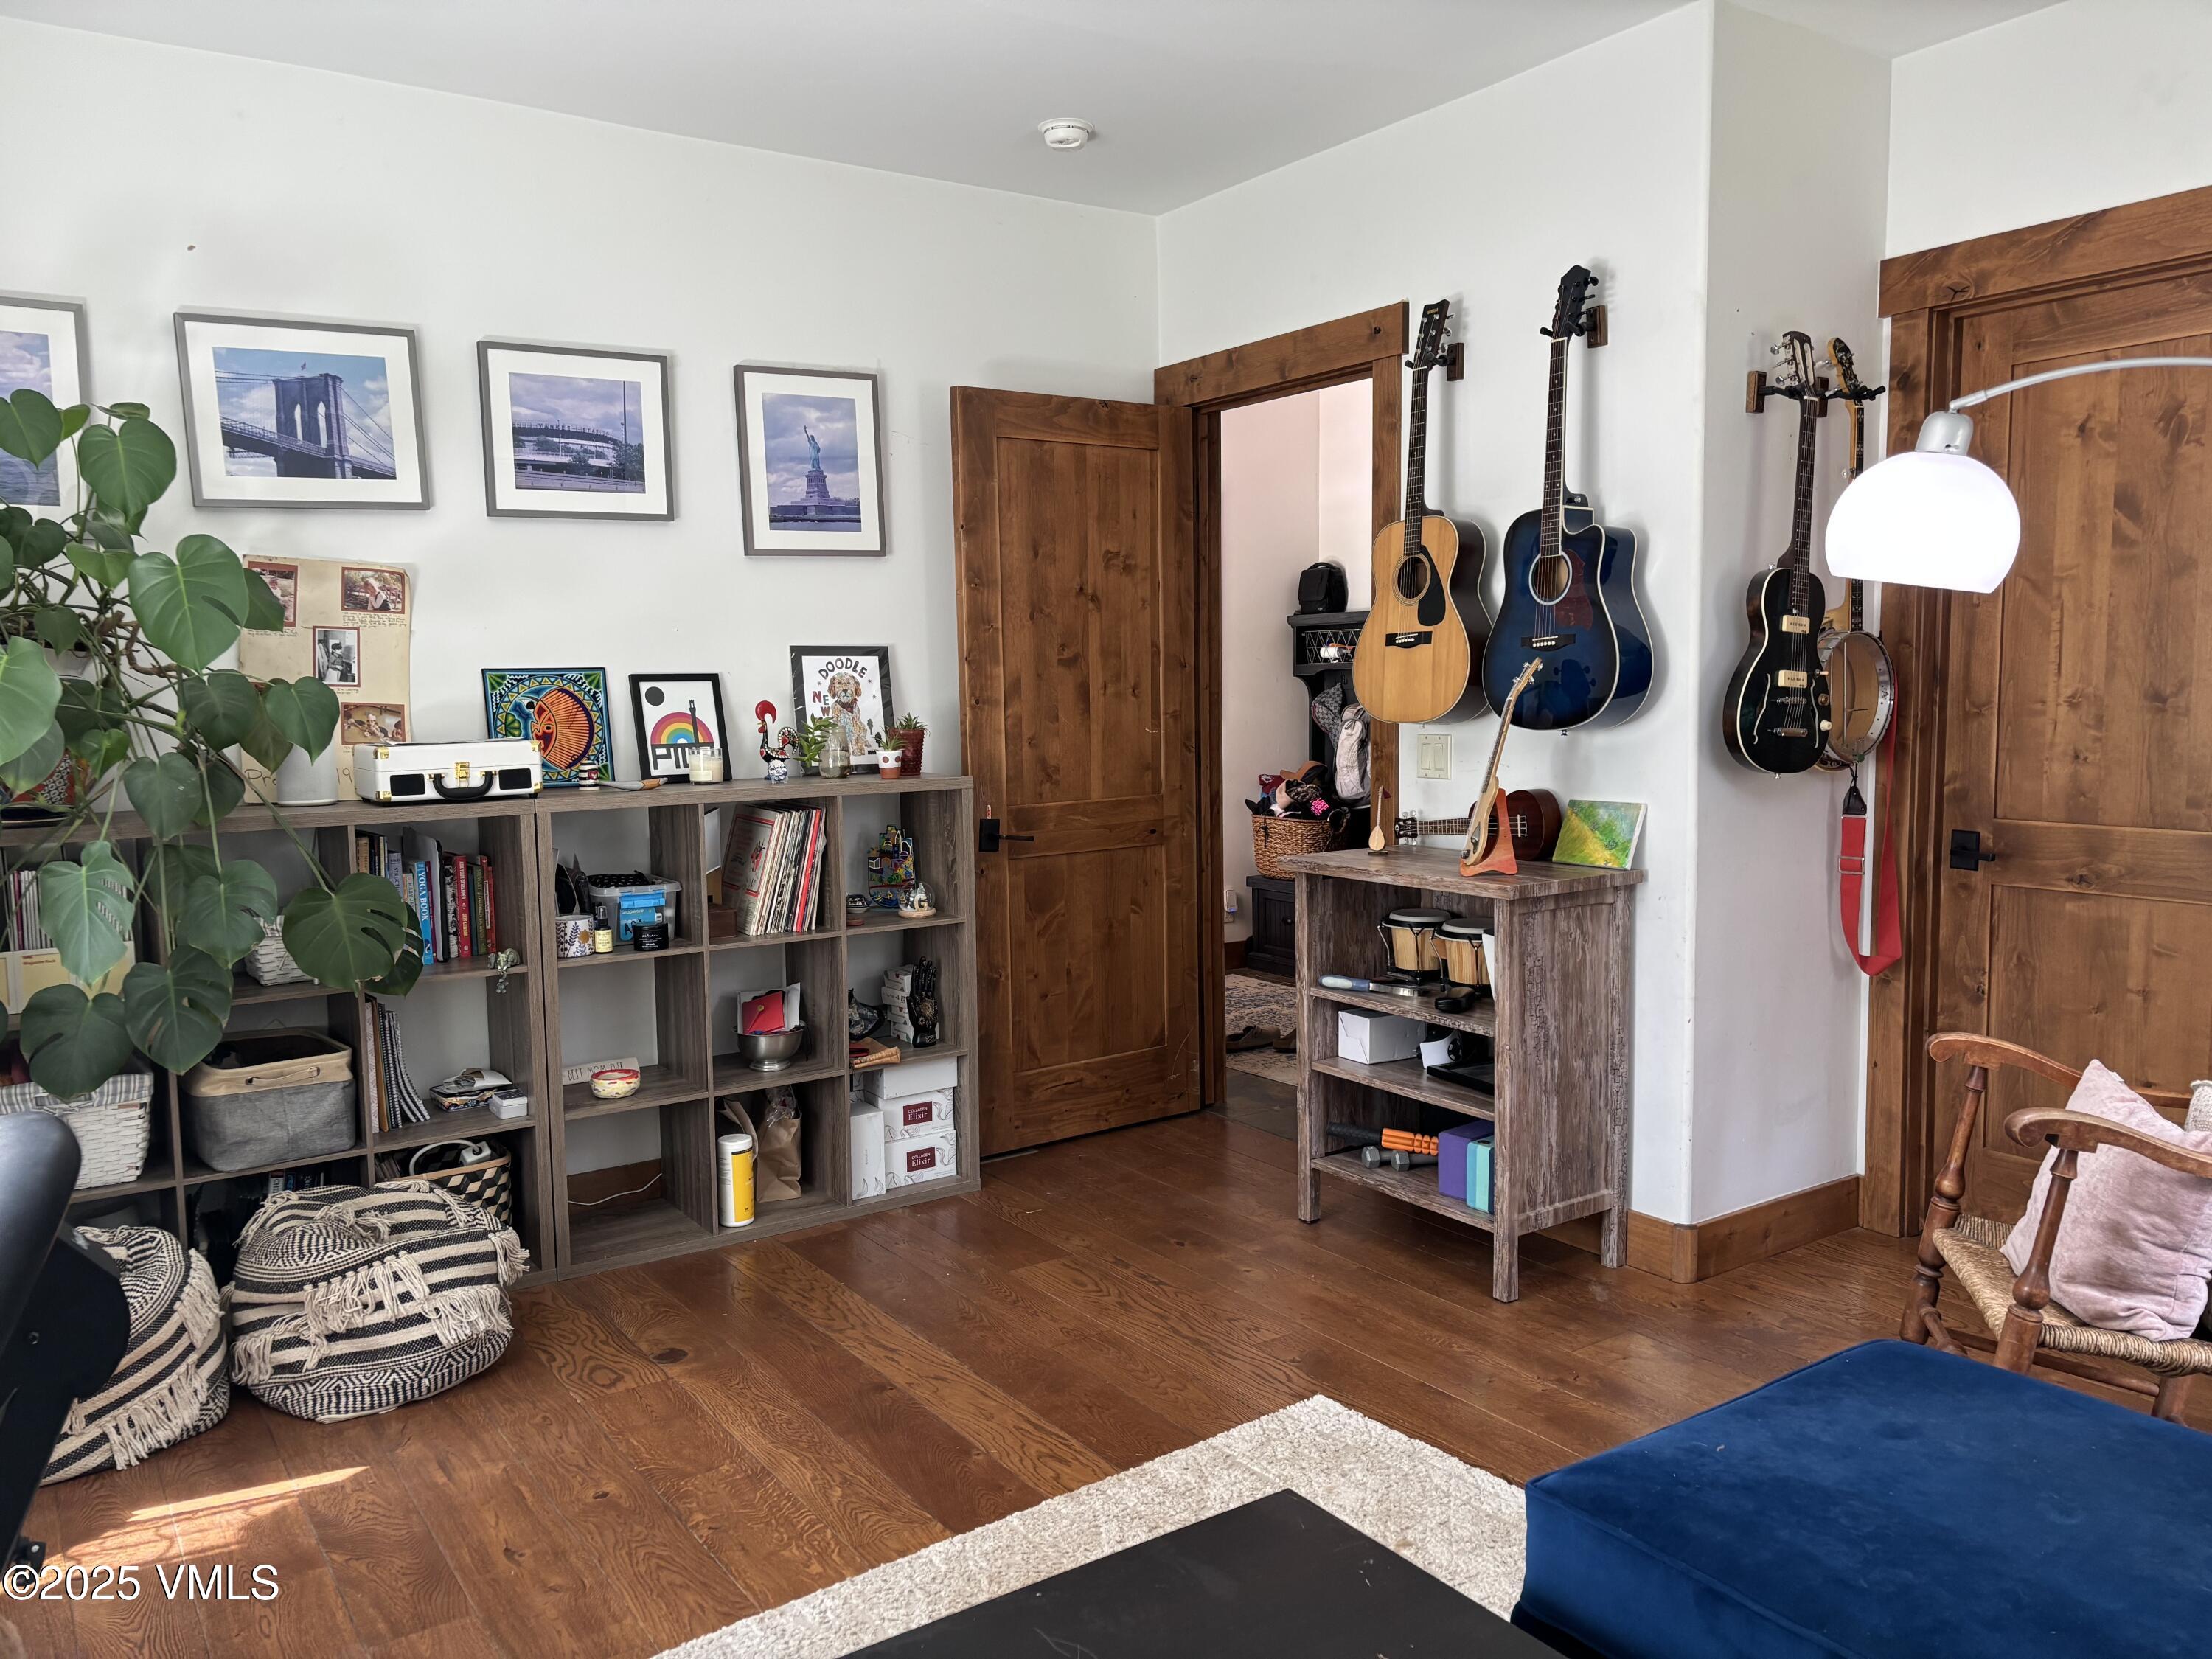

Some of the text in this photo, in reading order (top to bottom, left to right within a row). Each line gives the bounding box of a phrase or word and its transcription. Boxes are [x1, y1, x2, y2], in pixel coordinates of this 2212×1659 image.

[818, 657, 868, 680] DOODLE
[1312, 800, 1324, 814] GIRL
[1316, 797, 1329, 811] LIKE
[418, 872, 426, 896] YOGA
[420, 897, 429, 922] BOOK
[914, 894, 928, 911] G
[567, 1068, 583, 1081] BEST
[587, 1065, 605, 1077] MOM
[908, 1112, 928, 1121] Elixir
[911, 1158, 931, 1167] Elixir
